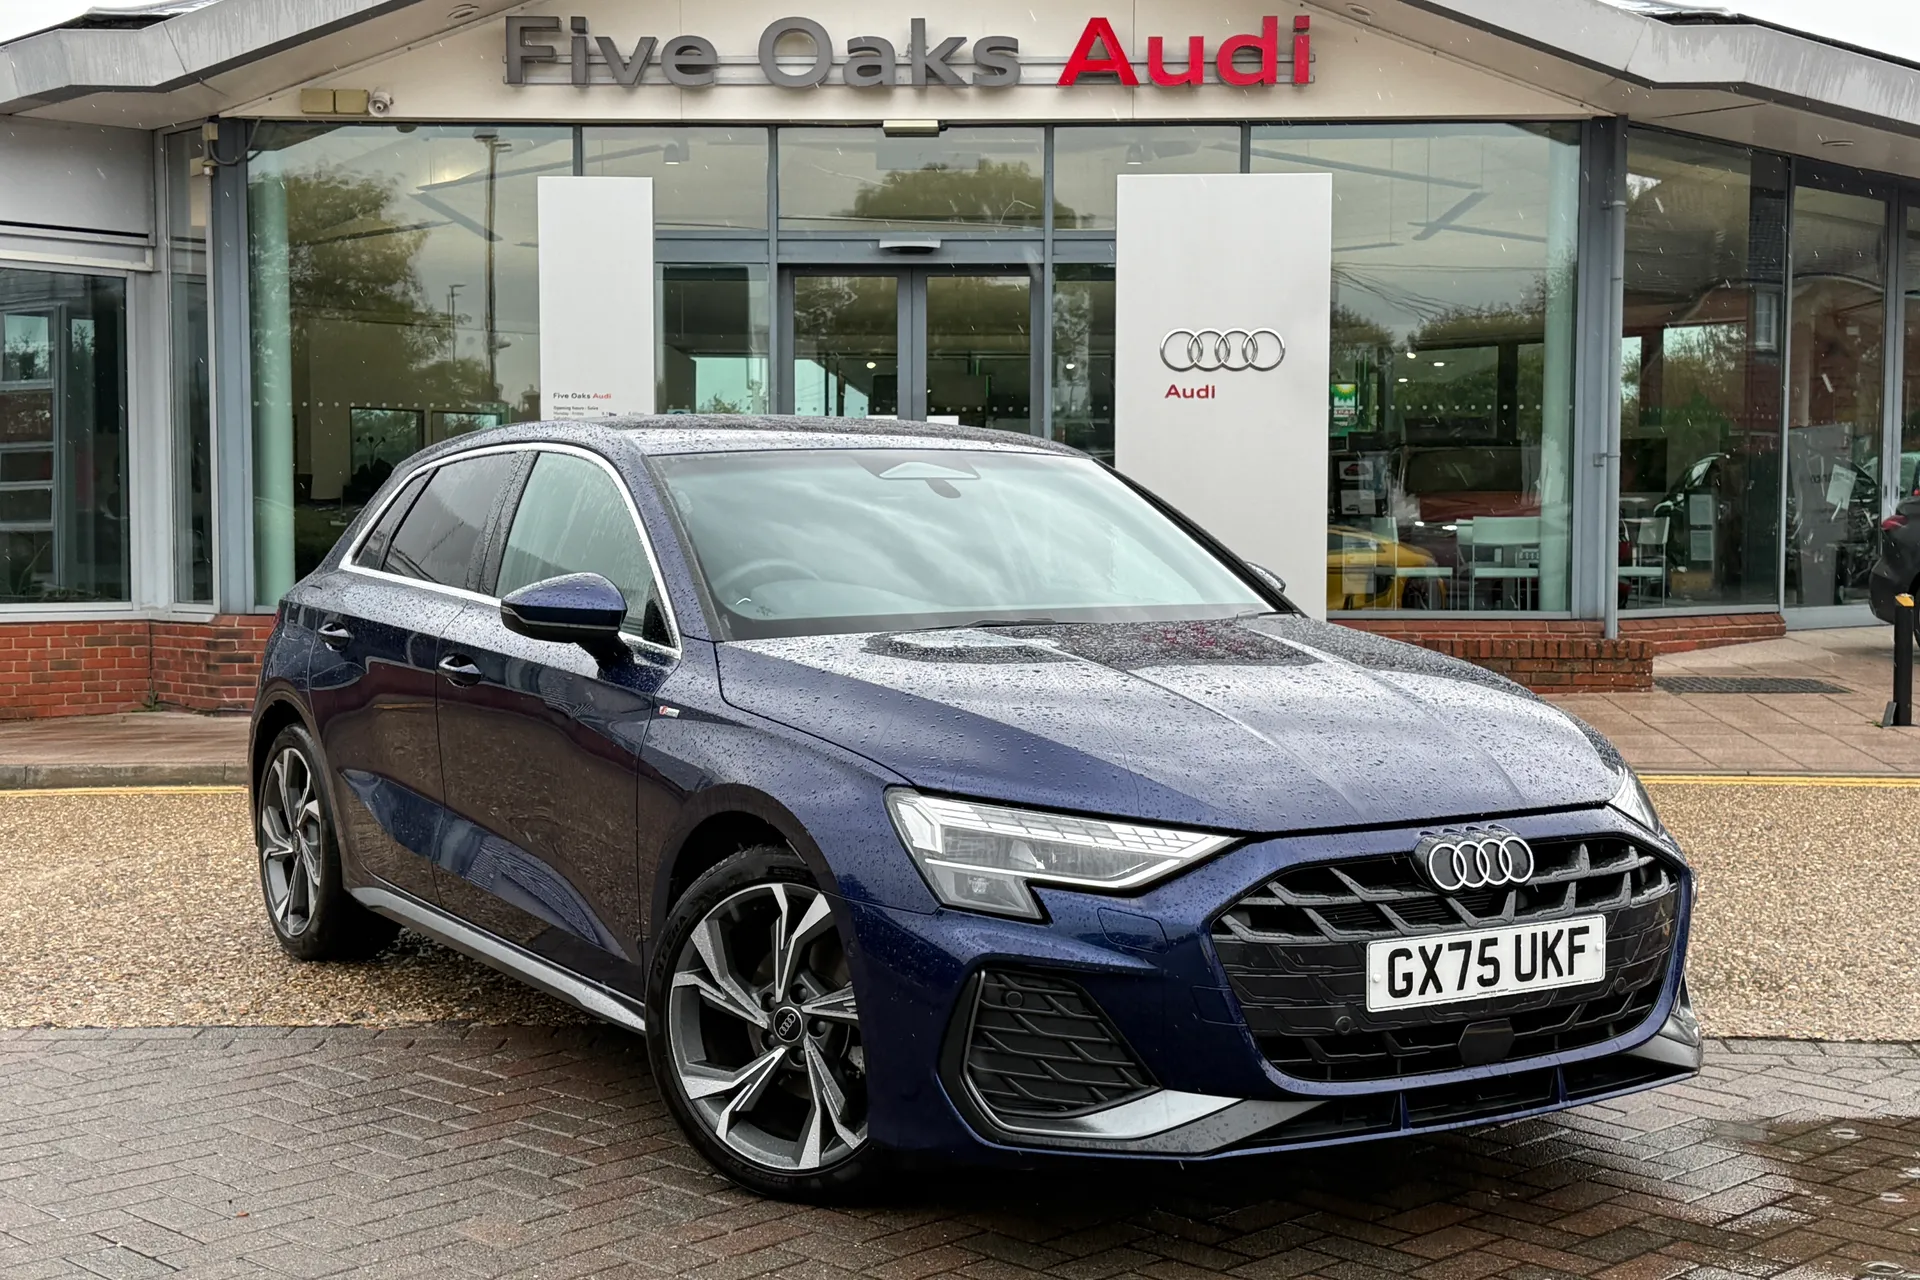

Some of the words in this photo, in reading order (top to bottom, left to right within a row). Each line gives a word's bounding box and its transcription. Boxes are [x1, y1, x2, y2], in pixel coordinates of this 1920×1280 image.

[505, 16, 719, 88] Five
[758, 16, 1021, 88] Oaks
[1056, 15, 1311, 87] Audi
[1164, 383, 1216, 399] Audi
[1387, 936, 1501, 999] GX75
[1514, 925, 1590, 983] UKF
